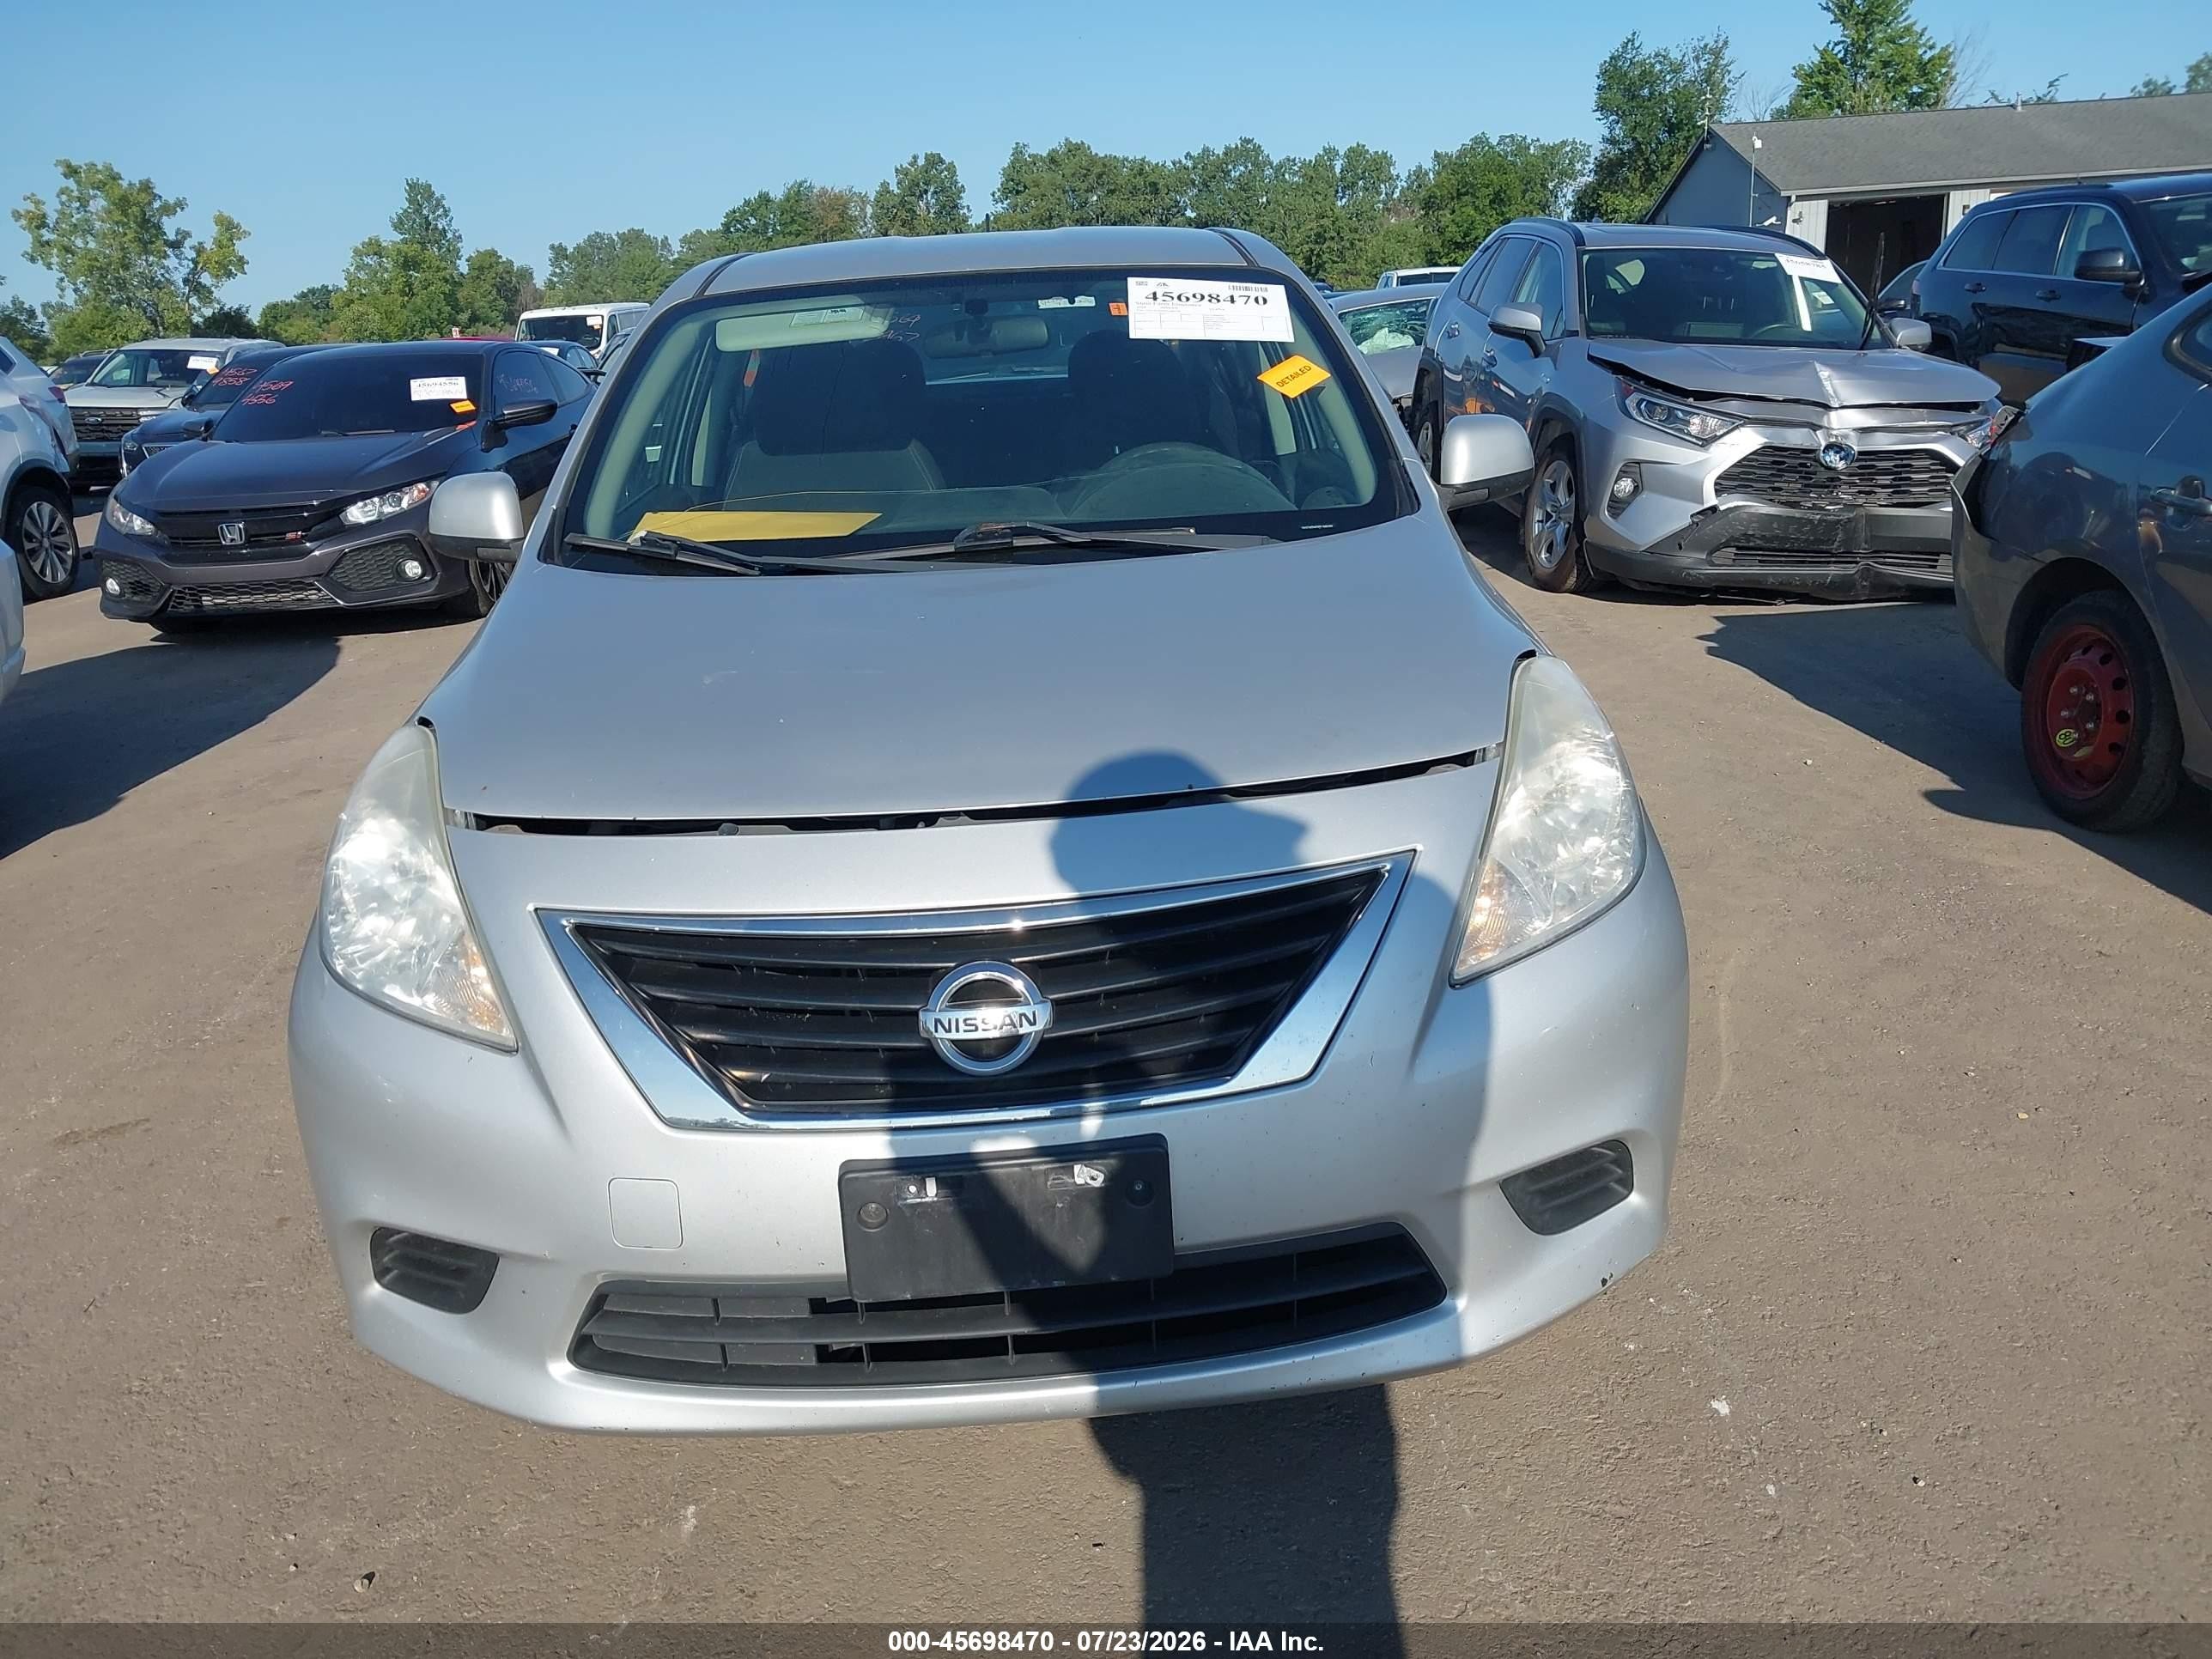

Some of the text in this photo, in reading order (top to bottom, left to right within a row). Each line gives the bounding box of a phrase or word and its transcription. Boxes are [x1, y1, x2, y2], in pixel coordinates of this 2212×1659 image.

[1145, 290, 1268, 307] 45698470
[1276, 365, 1312, 388] DETAILED
[933, 1010, 1037, 1034] NISSAN
